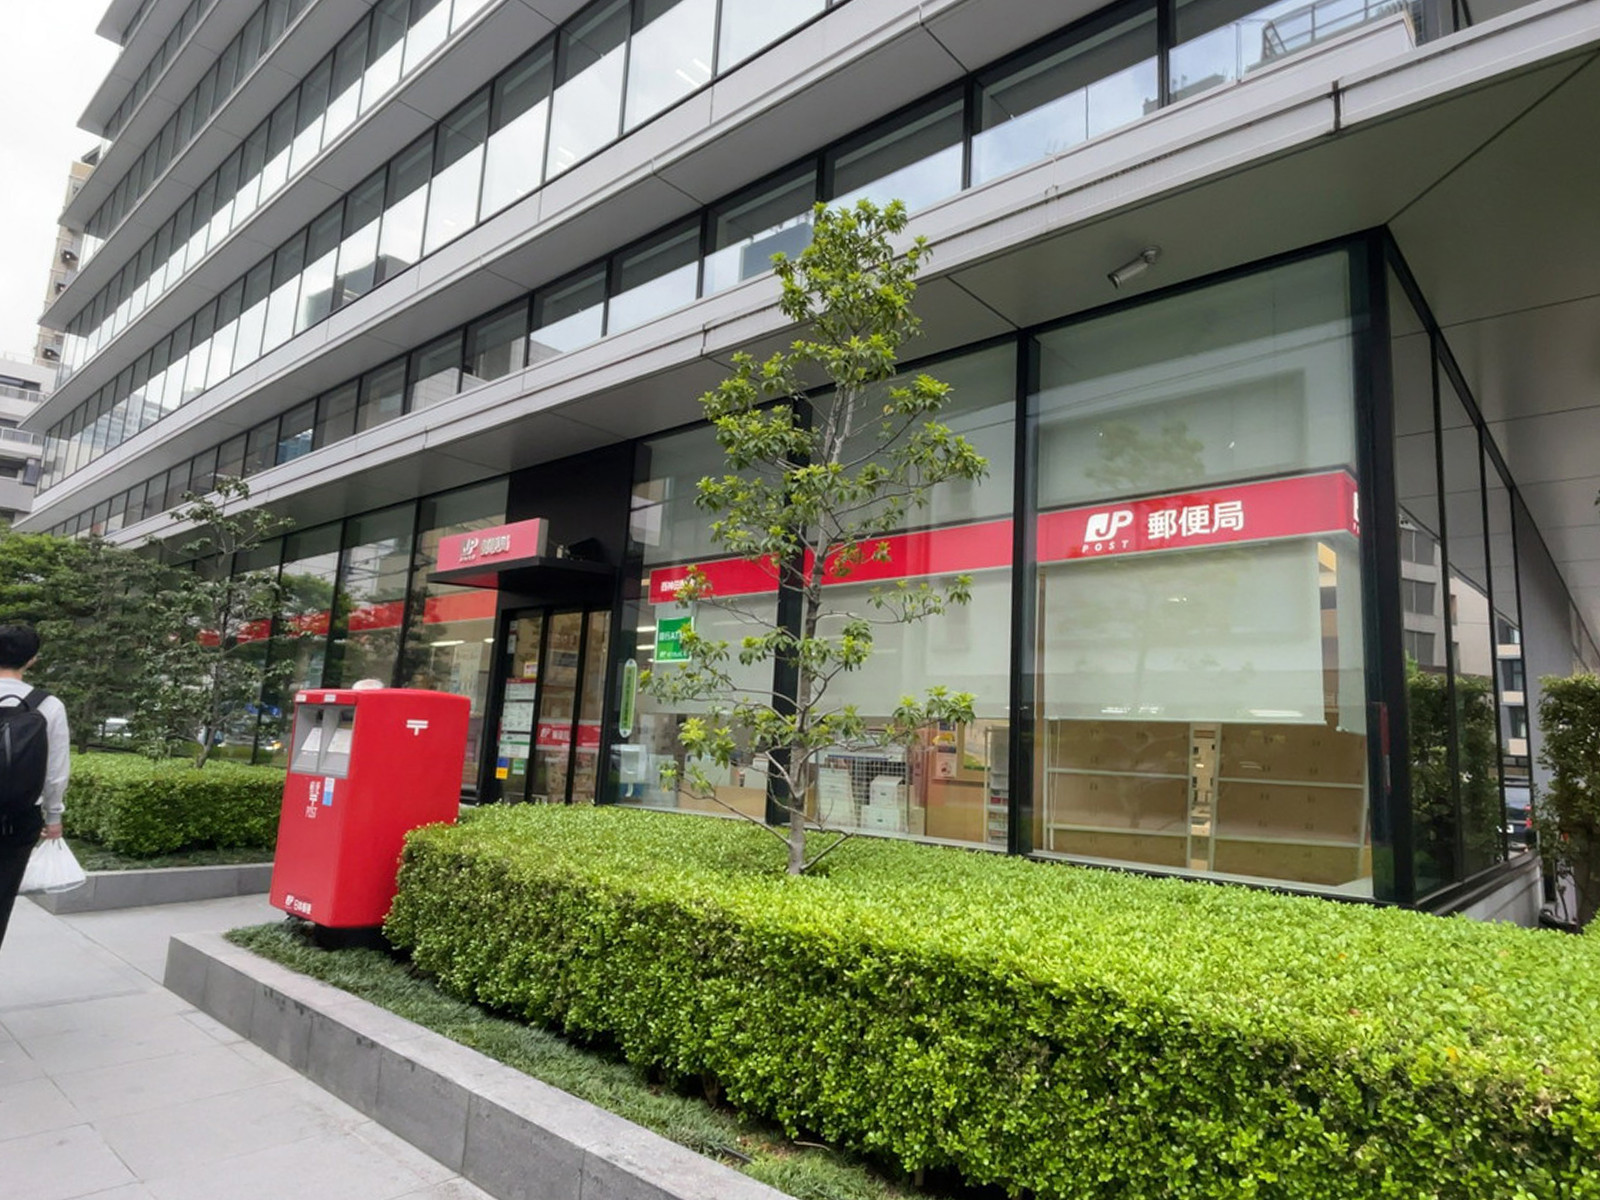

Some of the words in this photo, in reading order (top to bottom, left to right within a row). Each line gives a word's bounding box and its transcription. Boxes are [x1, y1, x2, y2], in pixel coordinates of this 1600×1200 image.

[1084, 510, 1134, 543] JP
[1147, 500, 1244, 540] 郵便局
[1081, 540, 1130, 553] POST
